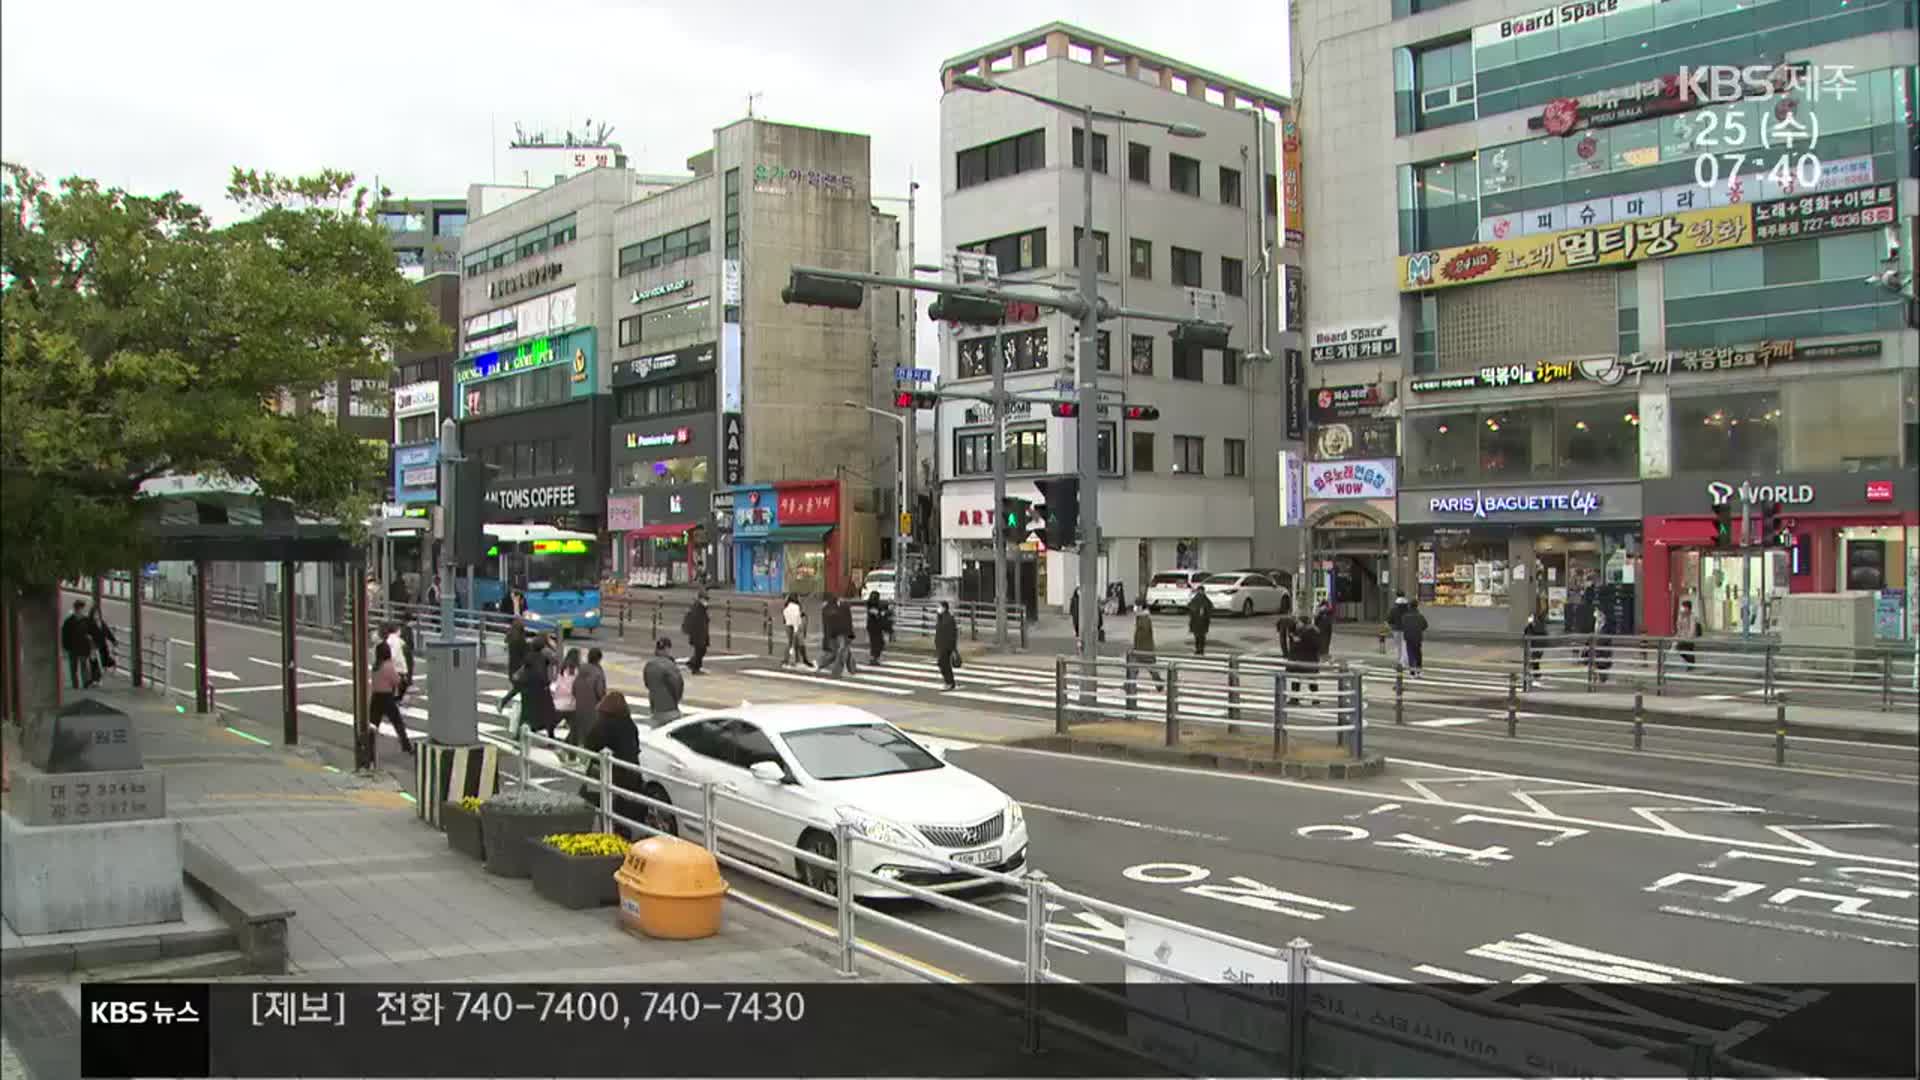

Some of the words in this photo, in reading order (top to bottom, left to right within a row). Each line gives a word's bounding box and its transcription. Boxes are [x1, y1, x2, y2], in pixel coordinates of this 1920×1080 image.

[1501, 10, 1554, 38] Board
[1561, 0, 1617, 23] Space
[1503, 243, 1556, 272] 노래
[1560, 220, 1682, 266] 멀티방
[1688, 216, 1748, 247] 영화
[1316, 330, 1348, 344] Board
[1351, 325, 1384, 340] Space
[1682, 347, 1756, 371] 볶음밥으로
[1481, 364, 1534, 386] 떡볶이로
[500, 488, 529, 510] TOMS
[531, 485, 575, 507] COFFEE
[1335, 483, 1363, 494] WOW
[1430, 498, 1474, 512] PARIS
[1485, 495, 1569, 511] BAGUETTE
